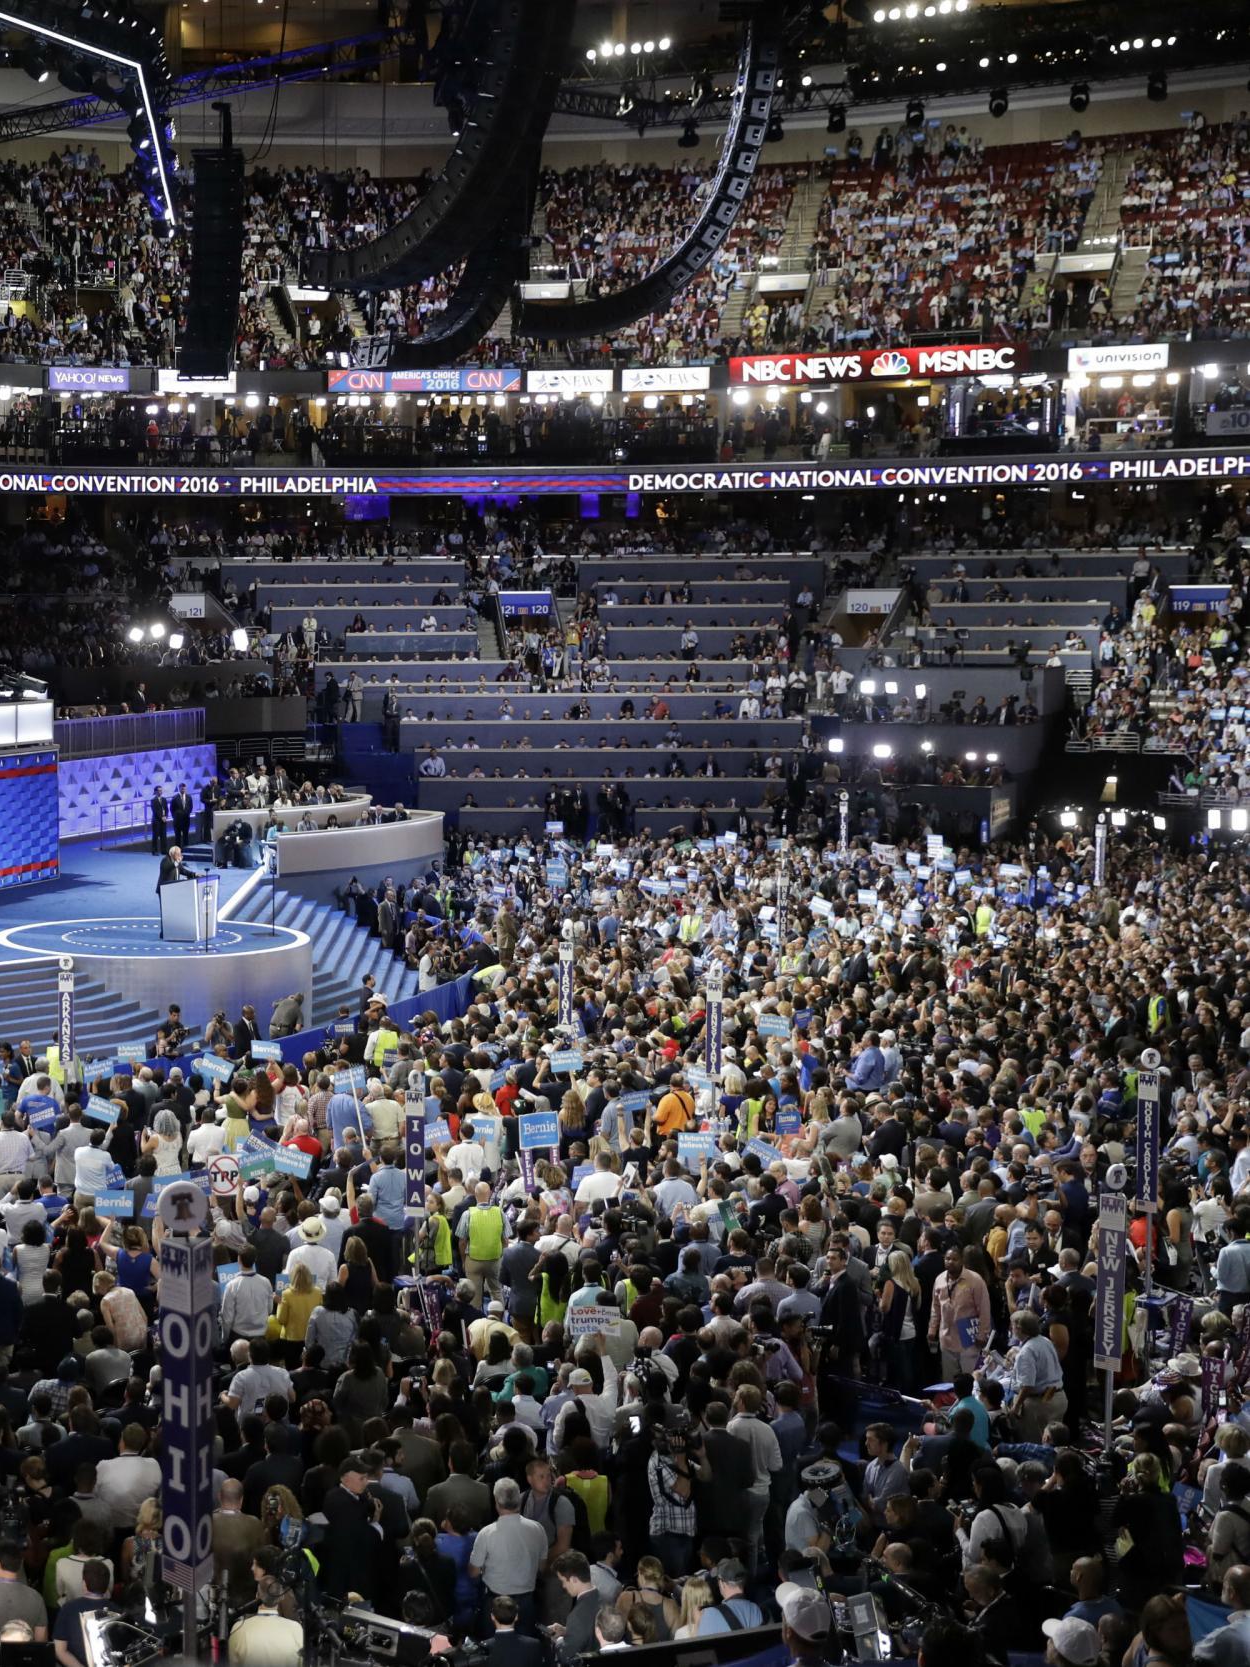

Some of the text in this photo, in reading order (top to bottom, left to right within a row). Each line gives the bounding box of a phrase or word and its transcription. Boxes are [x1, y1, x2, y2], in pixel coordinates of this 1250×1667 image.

[742, 347, 1015, 382] NBC NEWS MSNBC
[55, 371, 124, 384] YAHOO! NEWS
[348, 373, 384, 389] CNN
[391, 371, 460, 380] AMERICA'S CHOICE
[467, 372, 502, 388] CNN
[561, 375, 603, 386] NEWS
[656, 373, 700, 385] NEWS
[426, 379, 460, 390] 2016
[51, 475, 175, 493] CONVENTION
[180, 477, 219, 493] 2016
[240, 476, 378, 493] PHILADELPHIA
[629, 472, 765, 491] DEMOCRATIC
[770, 469, 876, 488] NATIONAL
[881, 465, 1027, 485] CONVENTION
[1033, 463, 1082, 481] 2016
[190, 608, 202, 616] 121
[502, 605, 549, 614] 121 120
[851, 602, 868, 612] 120
[1173, 600, 1190, 611] 119
[561, 960, 570, 1025] VIRGINIA
[61, 992, 71, 1061] ARKANSAS
[709, 1002, 717, 1074] PENNSYLVANIA
[252, 1044, 281, 1055] Bernie
[1144, 1101, 1153, 1139] NORTH
[474, 1125, 493, 1134] ernie
[523, 1121, 558, 1135] Bernie
[408, 1119, 424, 1204] IOWA
[1143, 1141, 1152, 1202] CAROLINA
[95, 1194, 132, 1208] Bernie
[1102, 1231, 1121, 1271] NEW
[571, 1316, 610, 1325] trumps
[1101, 1276, 1118, 1356] JERSEY
[572, 1325, 598, 1333] hate
[162, 1313, 191, 1562] OHIO
[195, 1311, 212, 1561] OHIO
